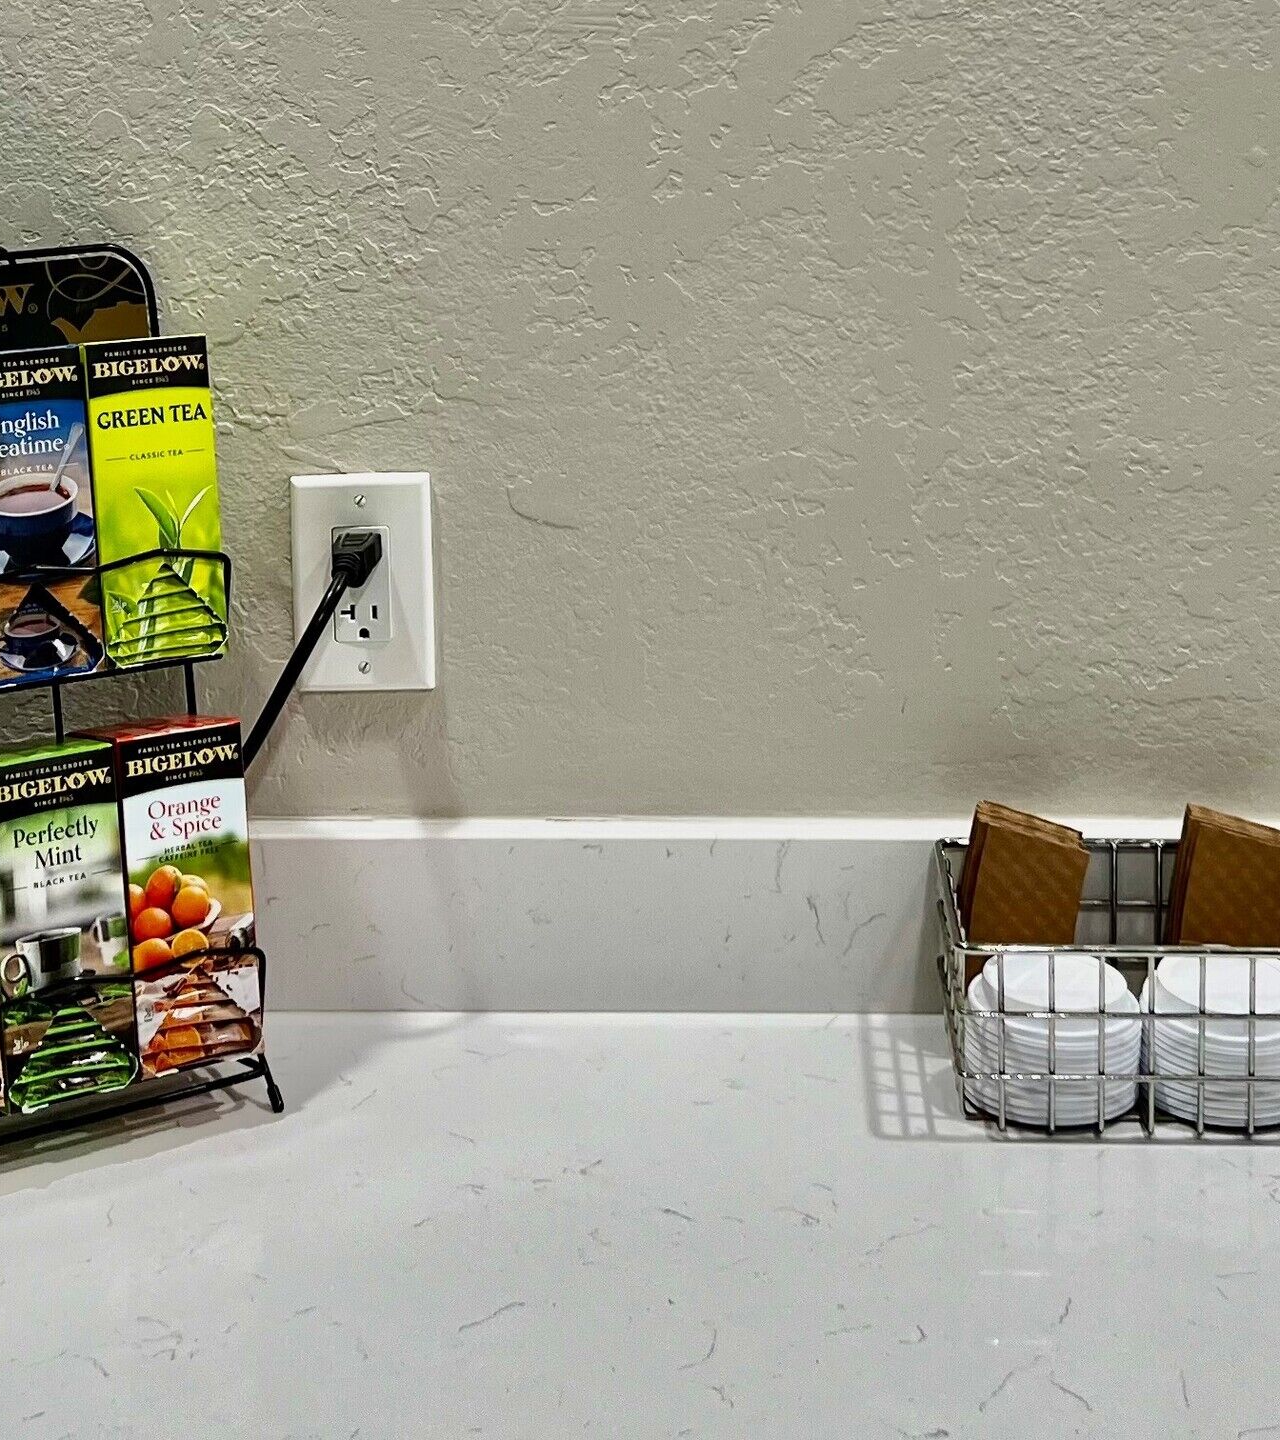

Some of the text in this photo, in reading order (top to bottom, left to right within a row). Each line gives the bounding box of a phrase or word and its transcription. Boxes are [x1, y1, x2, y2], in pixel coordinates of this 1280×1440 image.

[20, 357, 60, 366] BLENDERS
[92, 354, 203, 378] BIGELOW
[97, 403, 207, 430] GREEN TEA
[129, 451, 165, 460] CLASSIC
[0, 463, 53, 476] BLACK TEA
[138, 745, 165, 754] FAMILY
[167, 742, 180, 750] TEA
[5, 759, 93, 780] FAMILY TEA BLENDERS
[125, 743, 238, 778] BIGELOW
[148, 795, 221, 819] Orange
[13, 814, 98, 848] Perfectly
[150, 814, 222, 840] & Spice
[35, 843, 82, 869] Mint
[164, 839, 213, 854] HERBAL TEA
[33, 872, 87, 889] BLACK TEA
